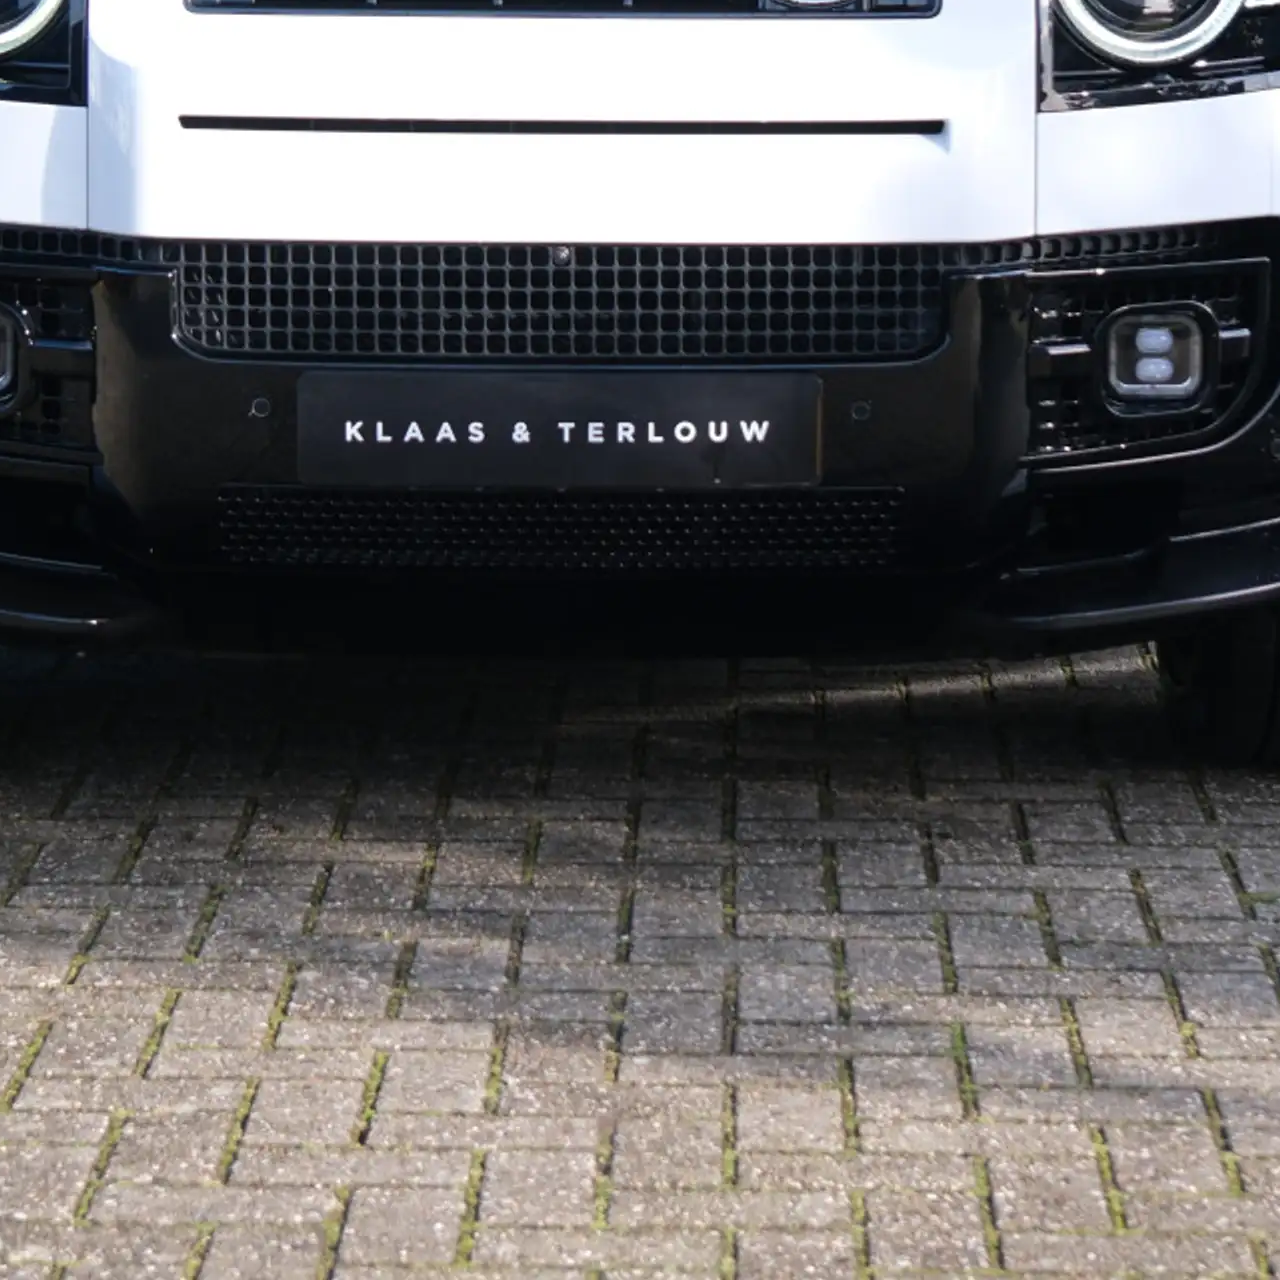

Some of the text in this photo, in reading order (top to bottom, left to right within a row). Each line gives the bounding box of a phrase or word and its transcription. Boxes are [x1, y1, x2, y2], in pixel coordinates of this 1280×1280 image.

[344, 419, 770, 444] KLAAS & TERLOUW
